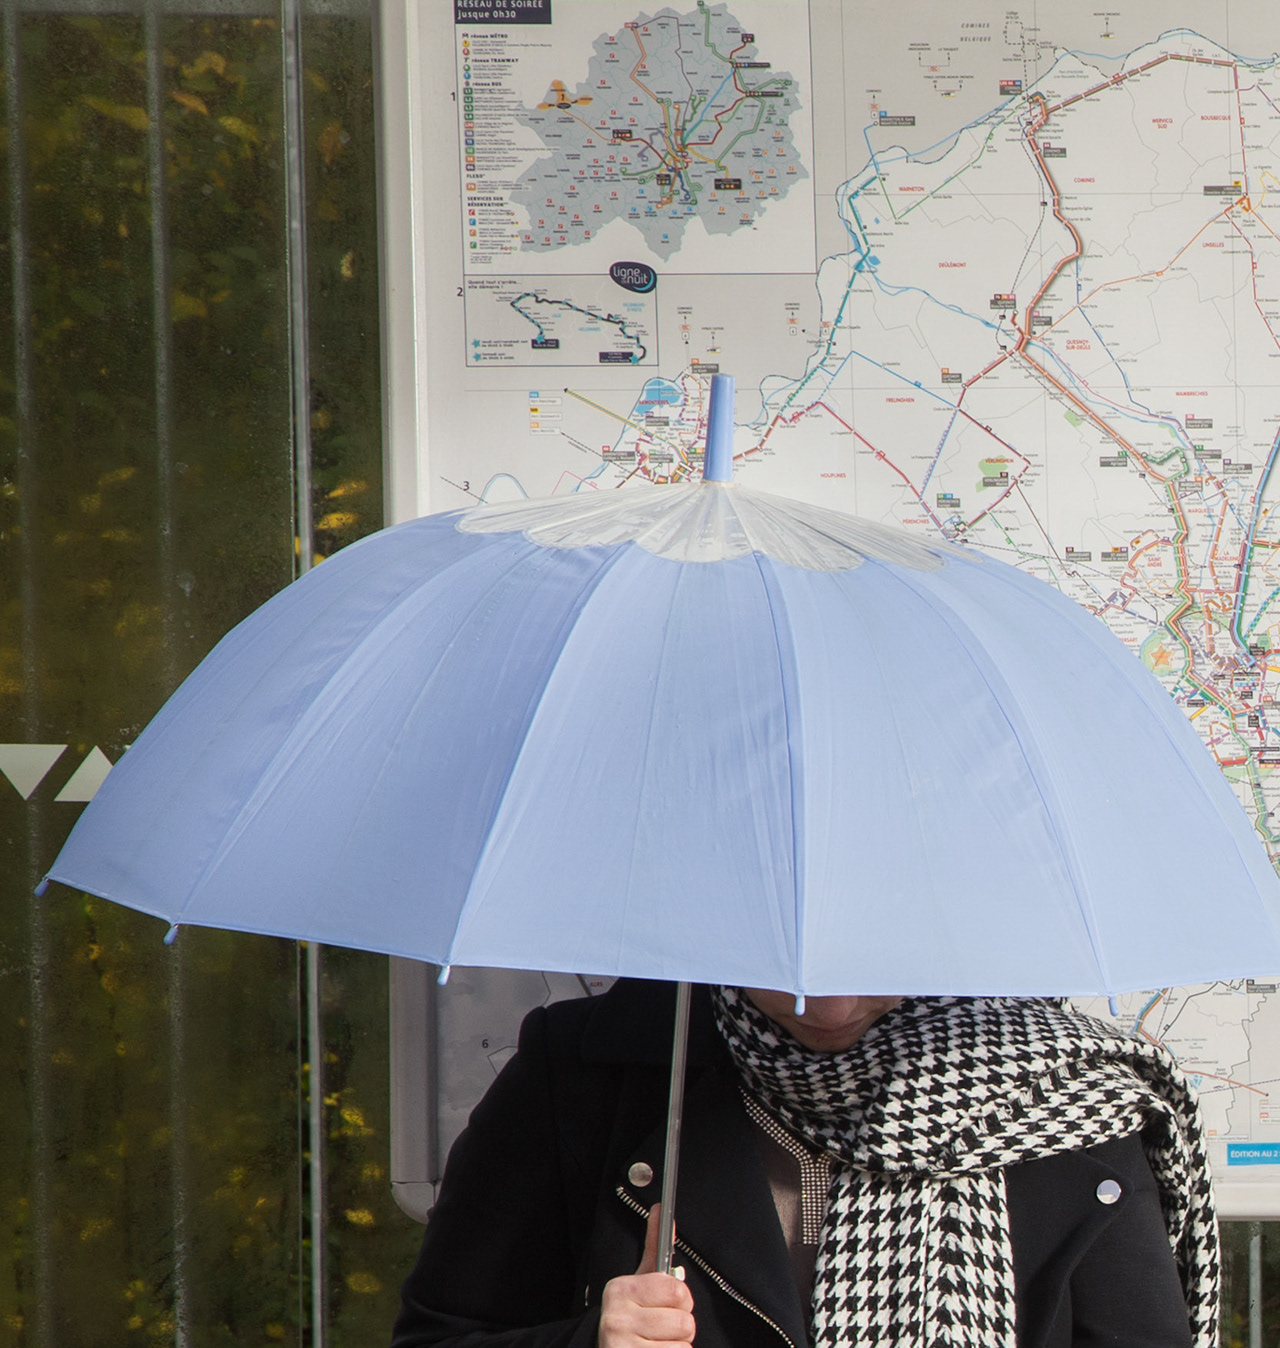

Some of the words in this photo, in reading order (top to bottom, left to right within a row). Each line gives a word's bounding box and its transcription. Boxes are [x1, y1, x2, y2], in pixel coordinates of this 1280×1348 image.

[458, 11, 489, 19] jusque
[613, 266, 640, 279] ligne
[627, 273, 648, 285] nuit
[457, 288, 463, 296] 2
[463, 481, 469, 490] 3
[482, 1039, 488, 1048] 6
[1231, 1150, 1259, 1158] ÉDITION
